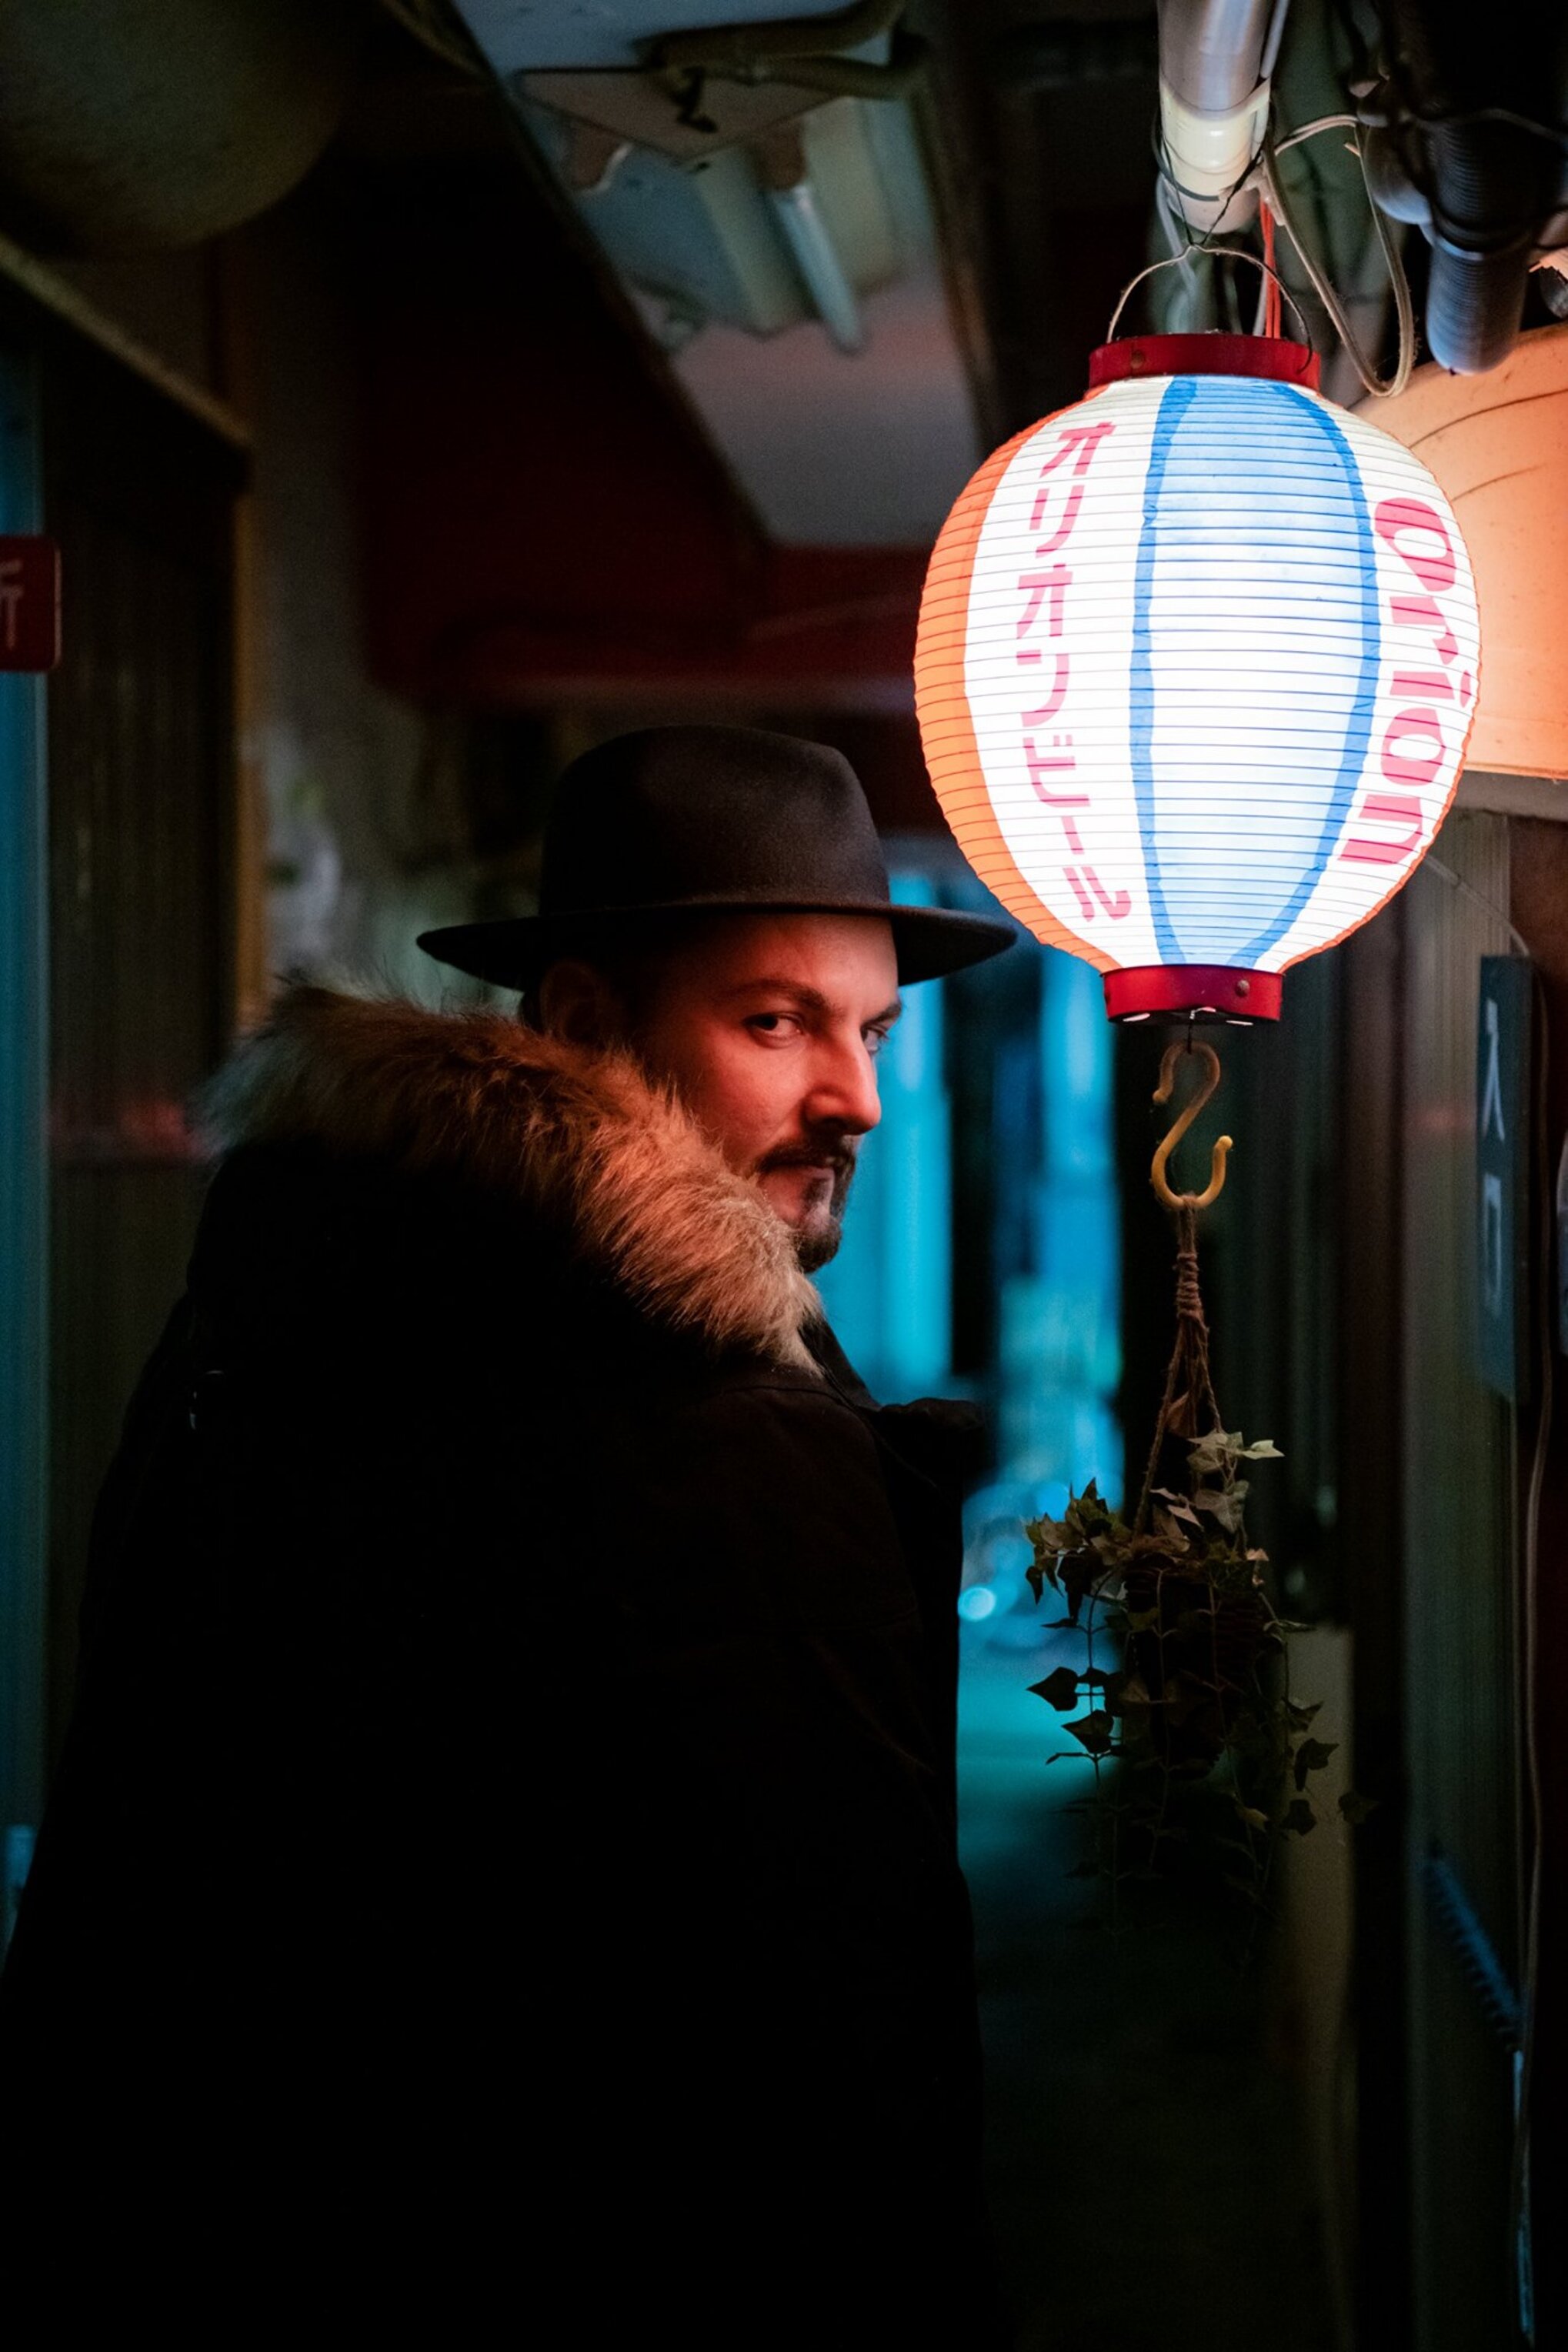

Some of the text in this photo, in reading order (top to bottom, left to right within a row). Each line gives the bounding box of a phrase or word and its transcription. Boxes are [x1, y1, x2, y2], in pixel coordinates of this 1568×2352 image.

[1016, 422, 1132, 922] オリオンビール
[1338, 498, 1472, 864] Orion
